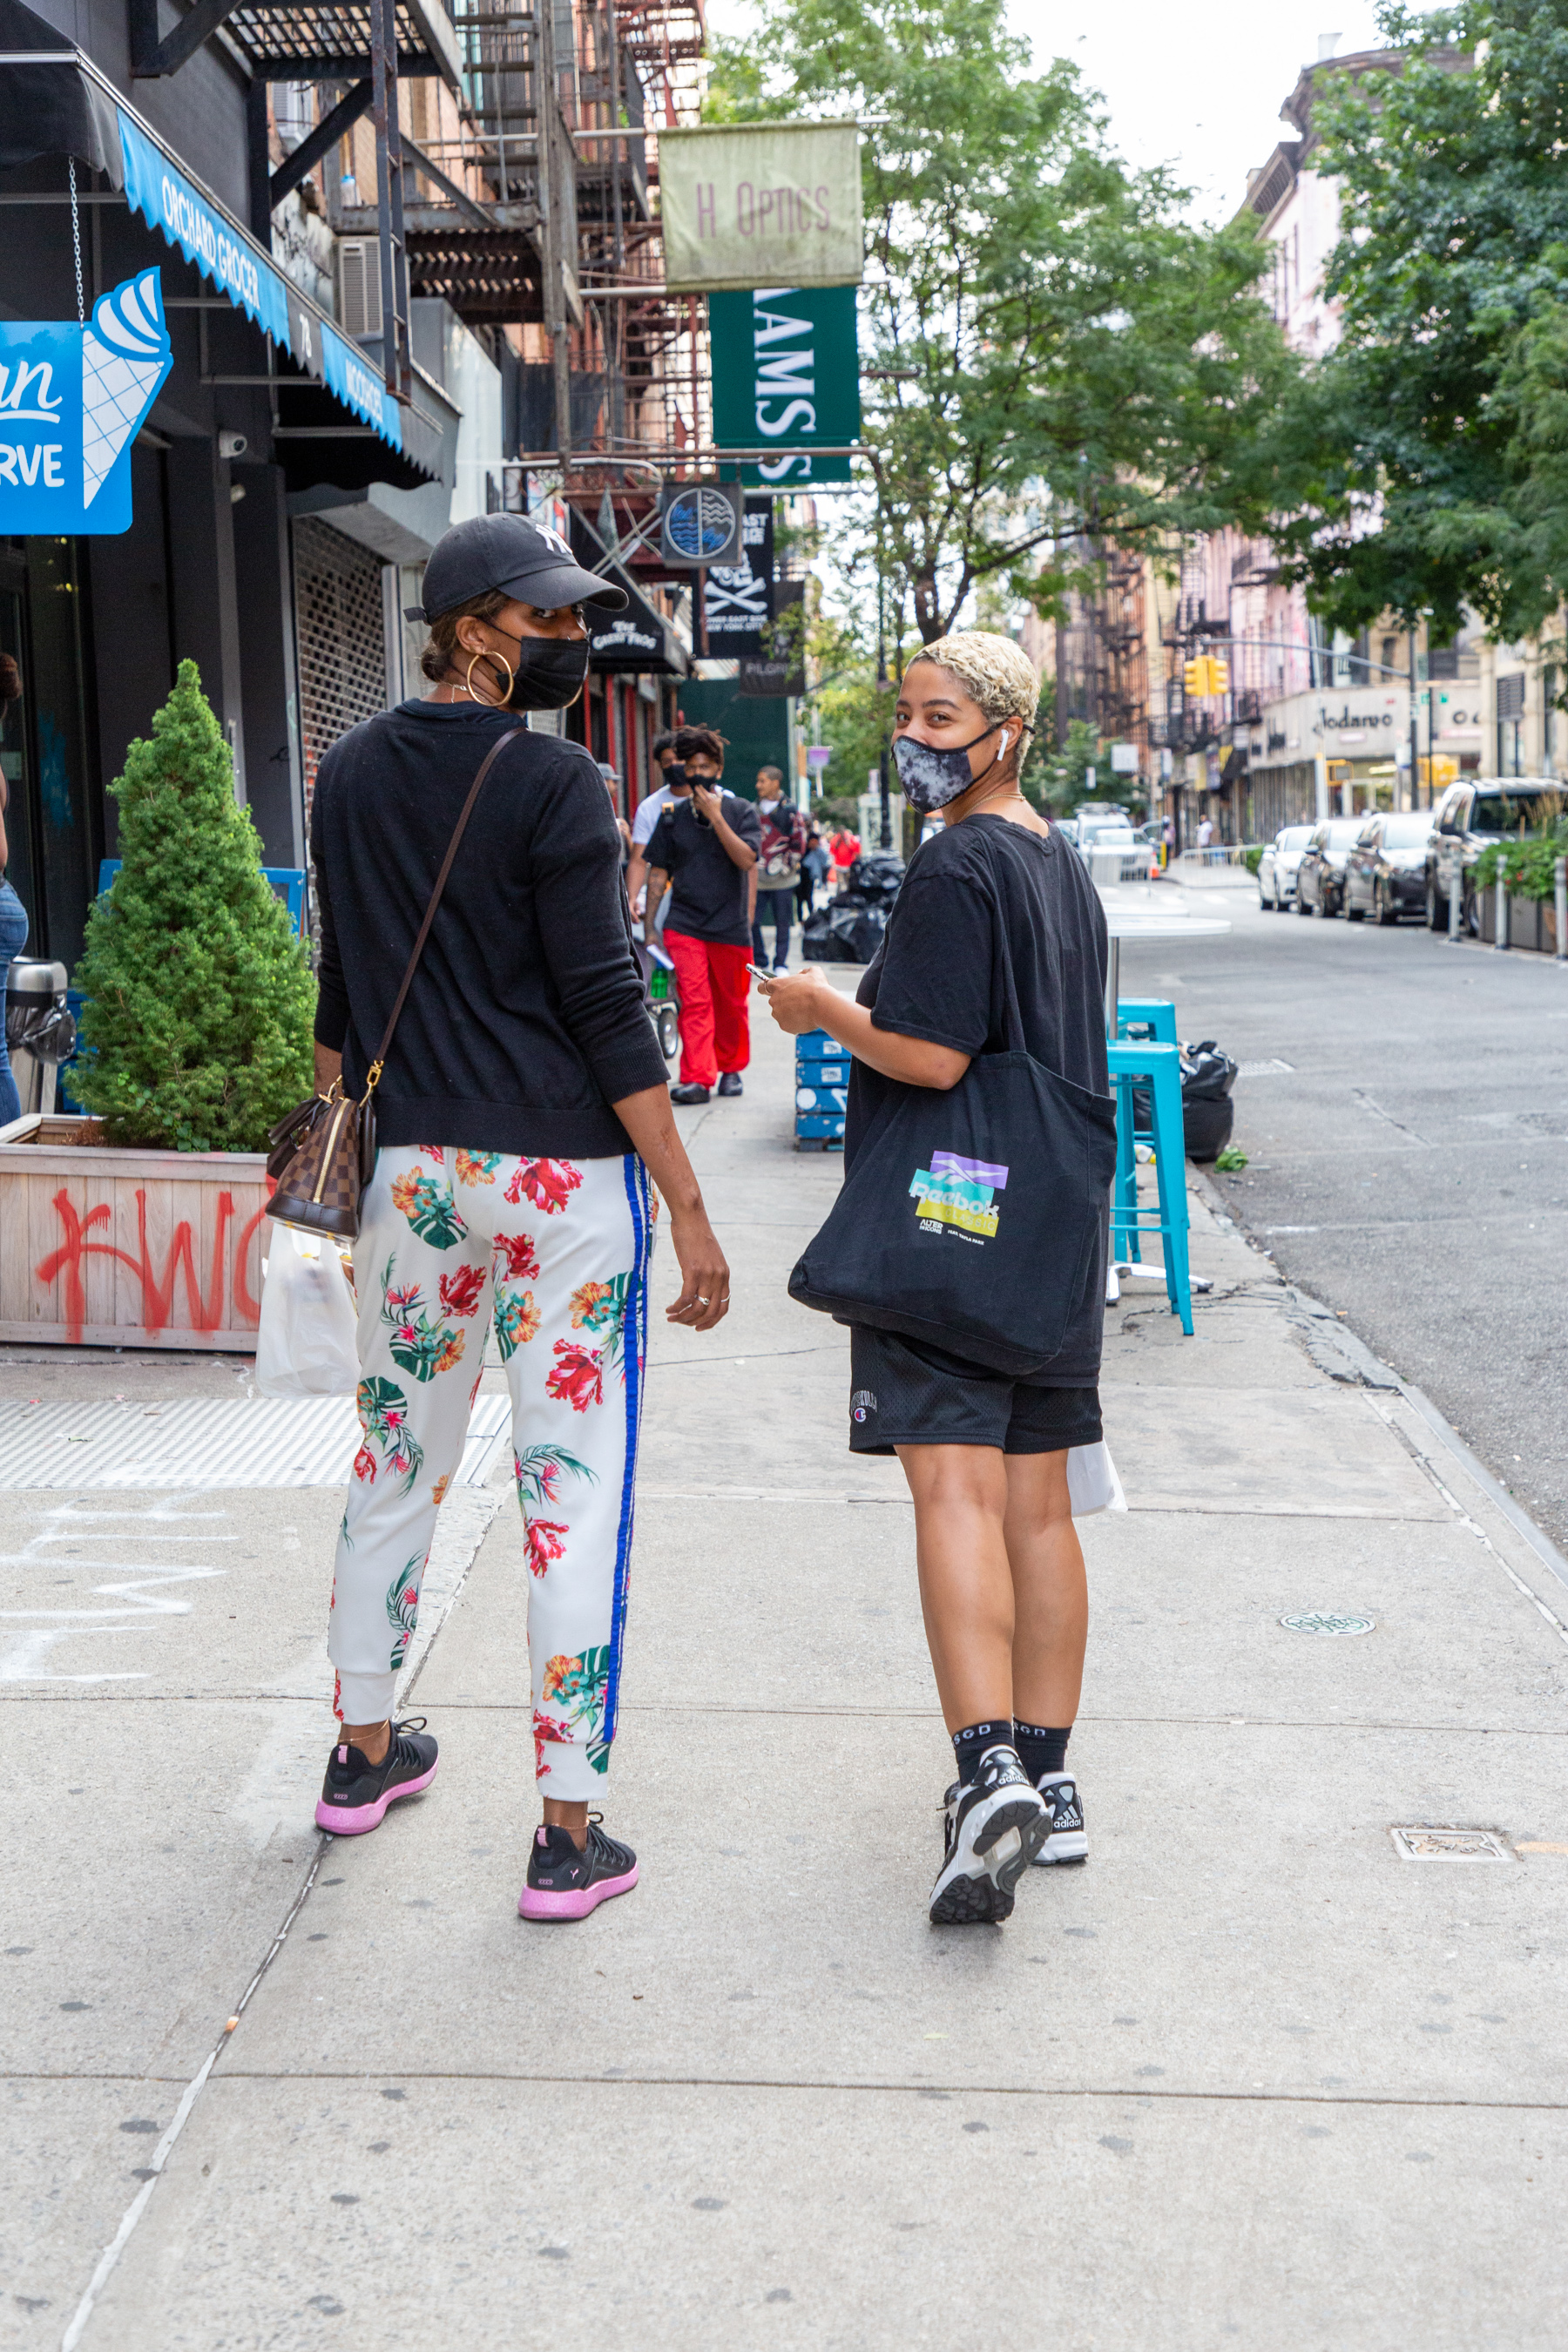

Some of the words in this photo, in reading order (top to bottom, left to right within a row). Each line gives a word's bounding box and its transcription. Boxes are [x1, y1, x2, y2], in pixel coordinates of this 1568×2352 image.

[697, 182, 717, 239] H
[162, 175, 216, 267] ORCHARD
[218, 232, 260, 310] GROCER
[909, 1181, 999, 1220] Reebok
[945, 1208, 996, 1231] CLASSIC
[998, 1775, 1030, 1786] adidas
[1053, 1818, 1081, 1828] adidas
